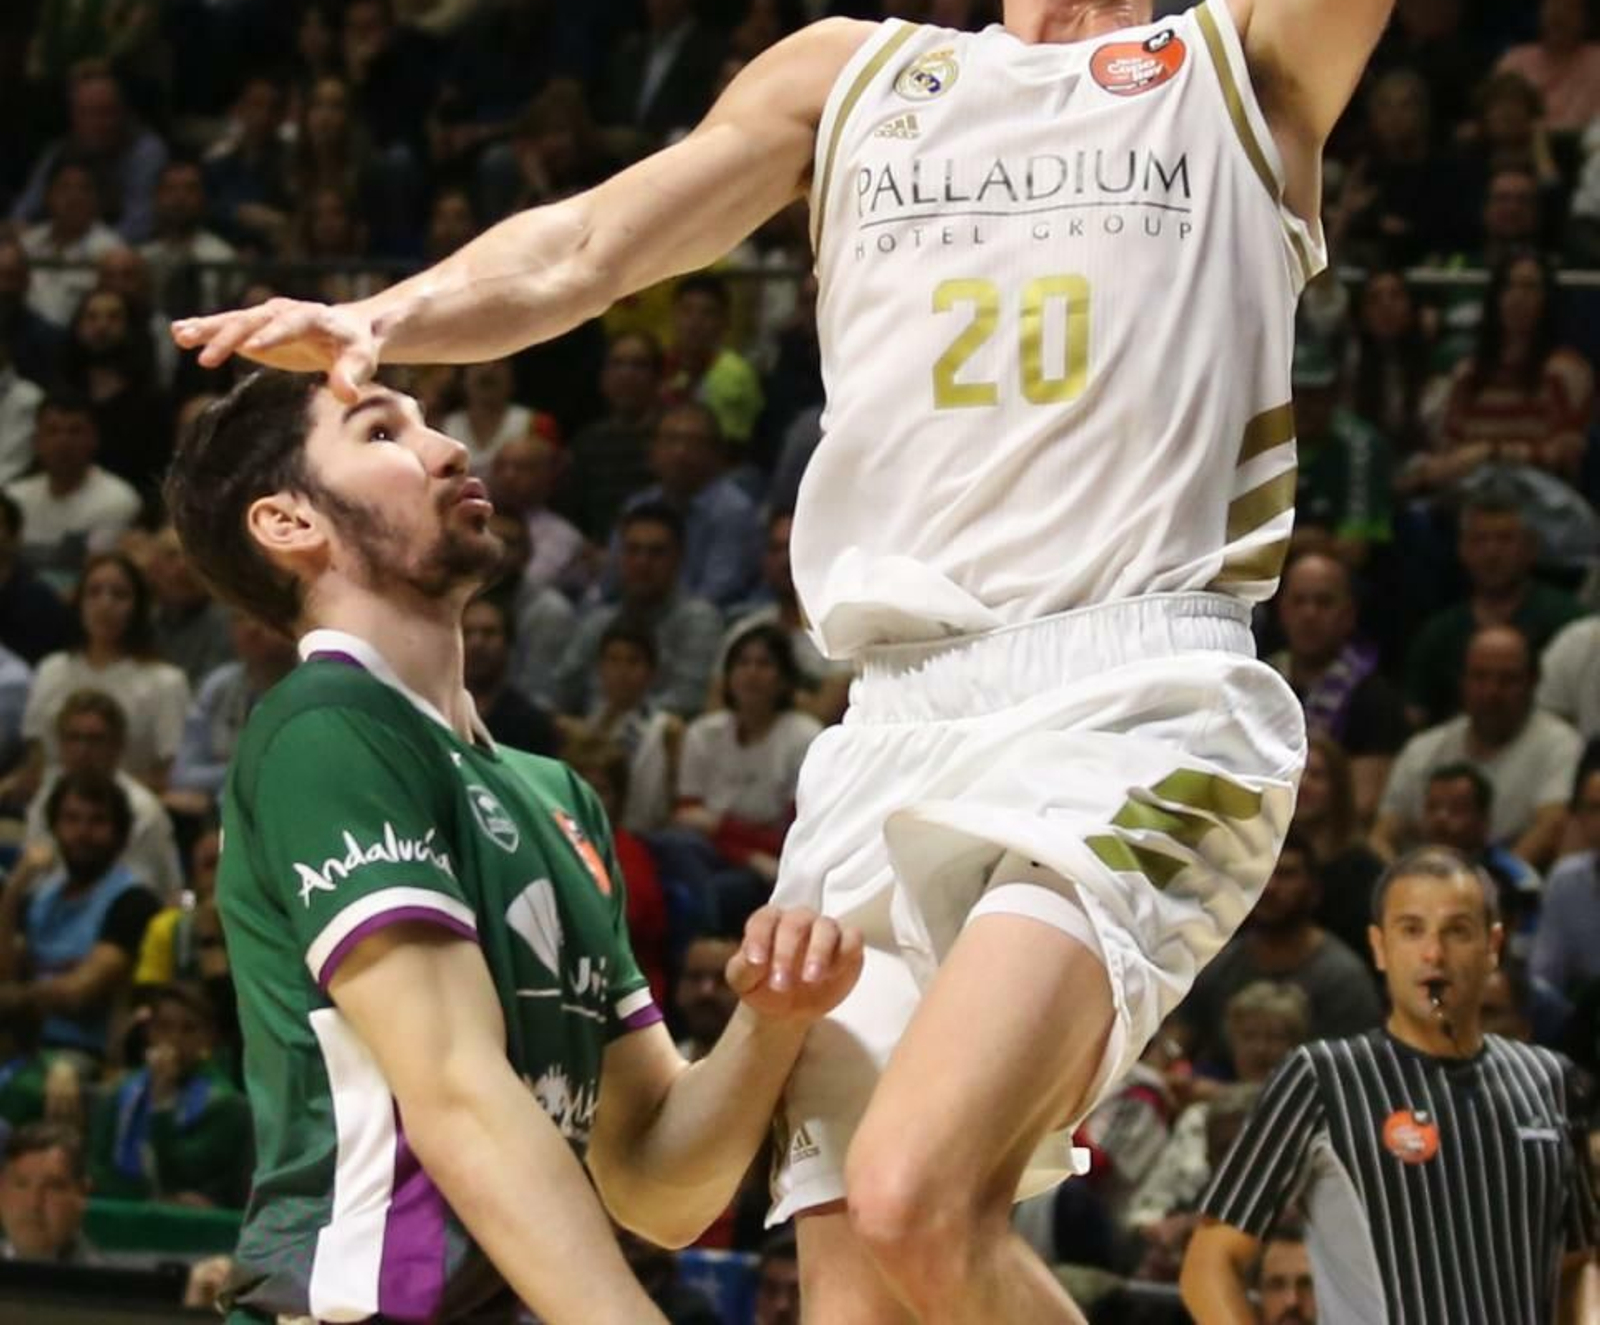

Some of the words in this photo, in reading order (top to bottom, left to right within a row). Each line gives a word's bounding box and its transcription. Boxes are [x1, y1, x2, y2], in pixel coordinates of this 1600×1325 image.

[857, 149, 1192, 218] PALLADIUM
[855, 225, 986, 260] HOTEL
[1032, 214, 1193, 242] GROUP
[931, 275, 1091, 411] 20
[292, 821, 456, 909] Andalucía
